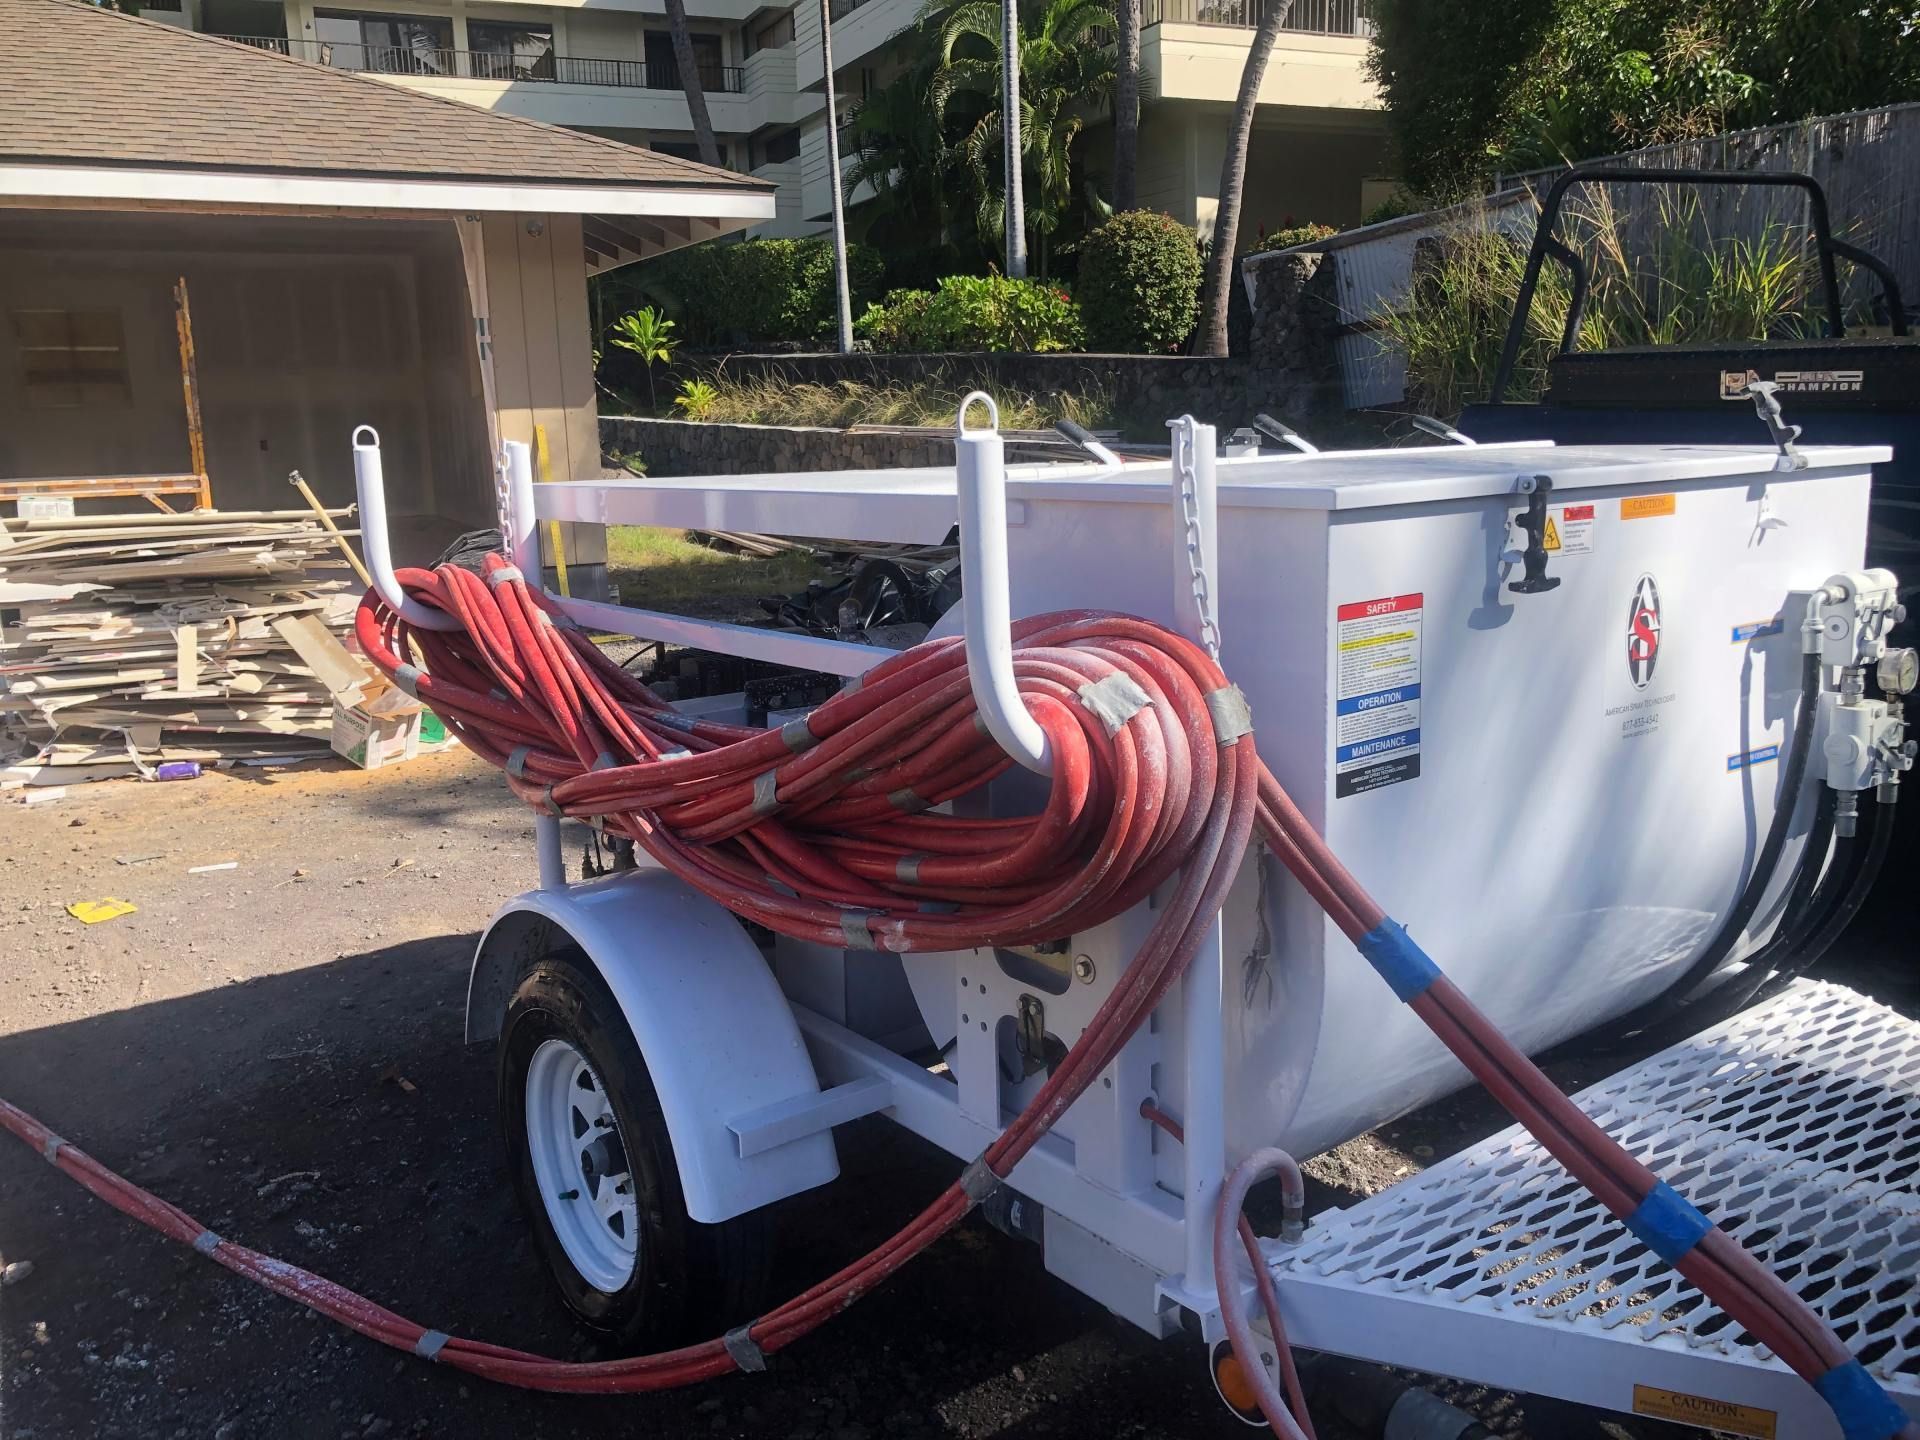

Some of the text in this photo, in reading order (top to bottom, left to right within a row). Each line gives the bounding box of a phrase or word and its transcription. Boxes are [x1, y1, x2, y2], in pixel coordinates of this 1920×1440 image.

[1777, 383, 1861, 391] CHAMPION
[1632, 498, 1664, 510] CAUTION
[1366, 601, 1397, 615] SAFETY
[1358, 692, 1402, 710] OPERATION
[343, 713, 366, 731] PURPOSE
[1352, 735, 1407, 758] MAINTENANCE
[1672, 1394, 1738, 1417] CAUTION
